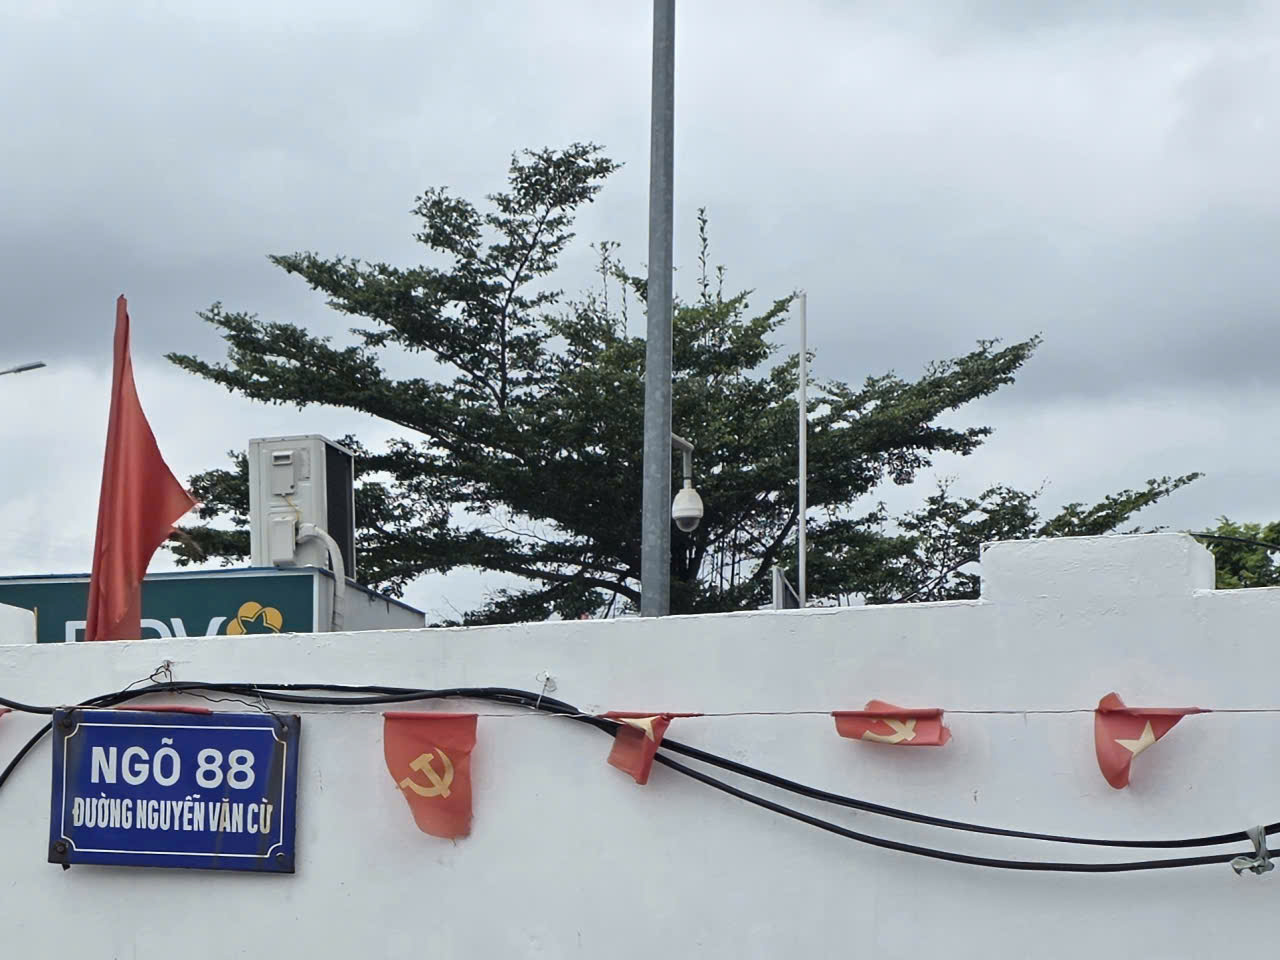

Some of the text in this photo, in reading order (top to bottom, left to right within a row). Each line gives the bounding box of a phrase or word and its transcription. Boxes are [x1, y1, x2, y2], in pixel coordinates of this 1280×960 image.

[90, 737, 256, 790] NGÕ 88
[72, 792, 274, 834] ĐƯỜNG NGUYỄN VĂN CỪ
